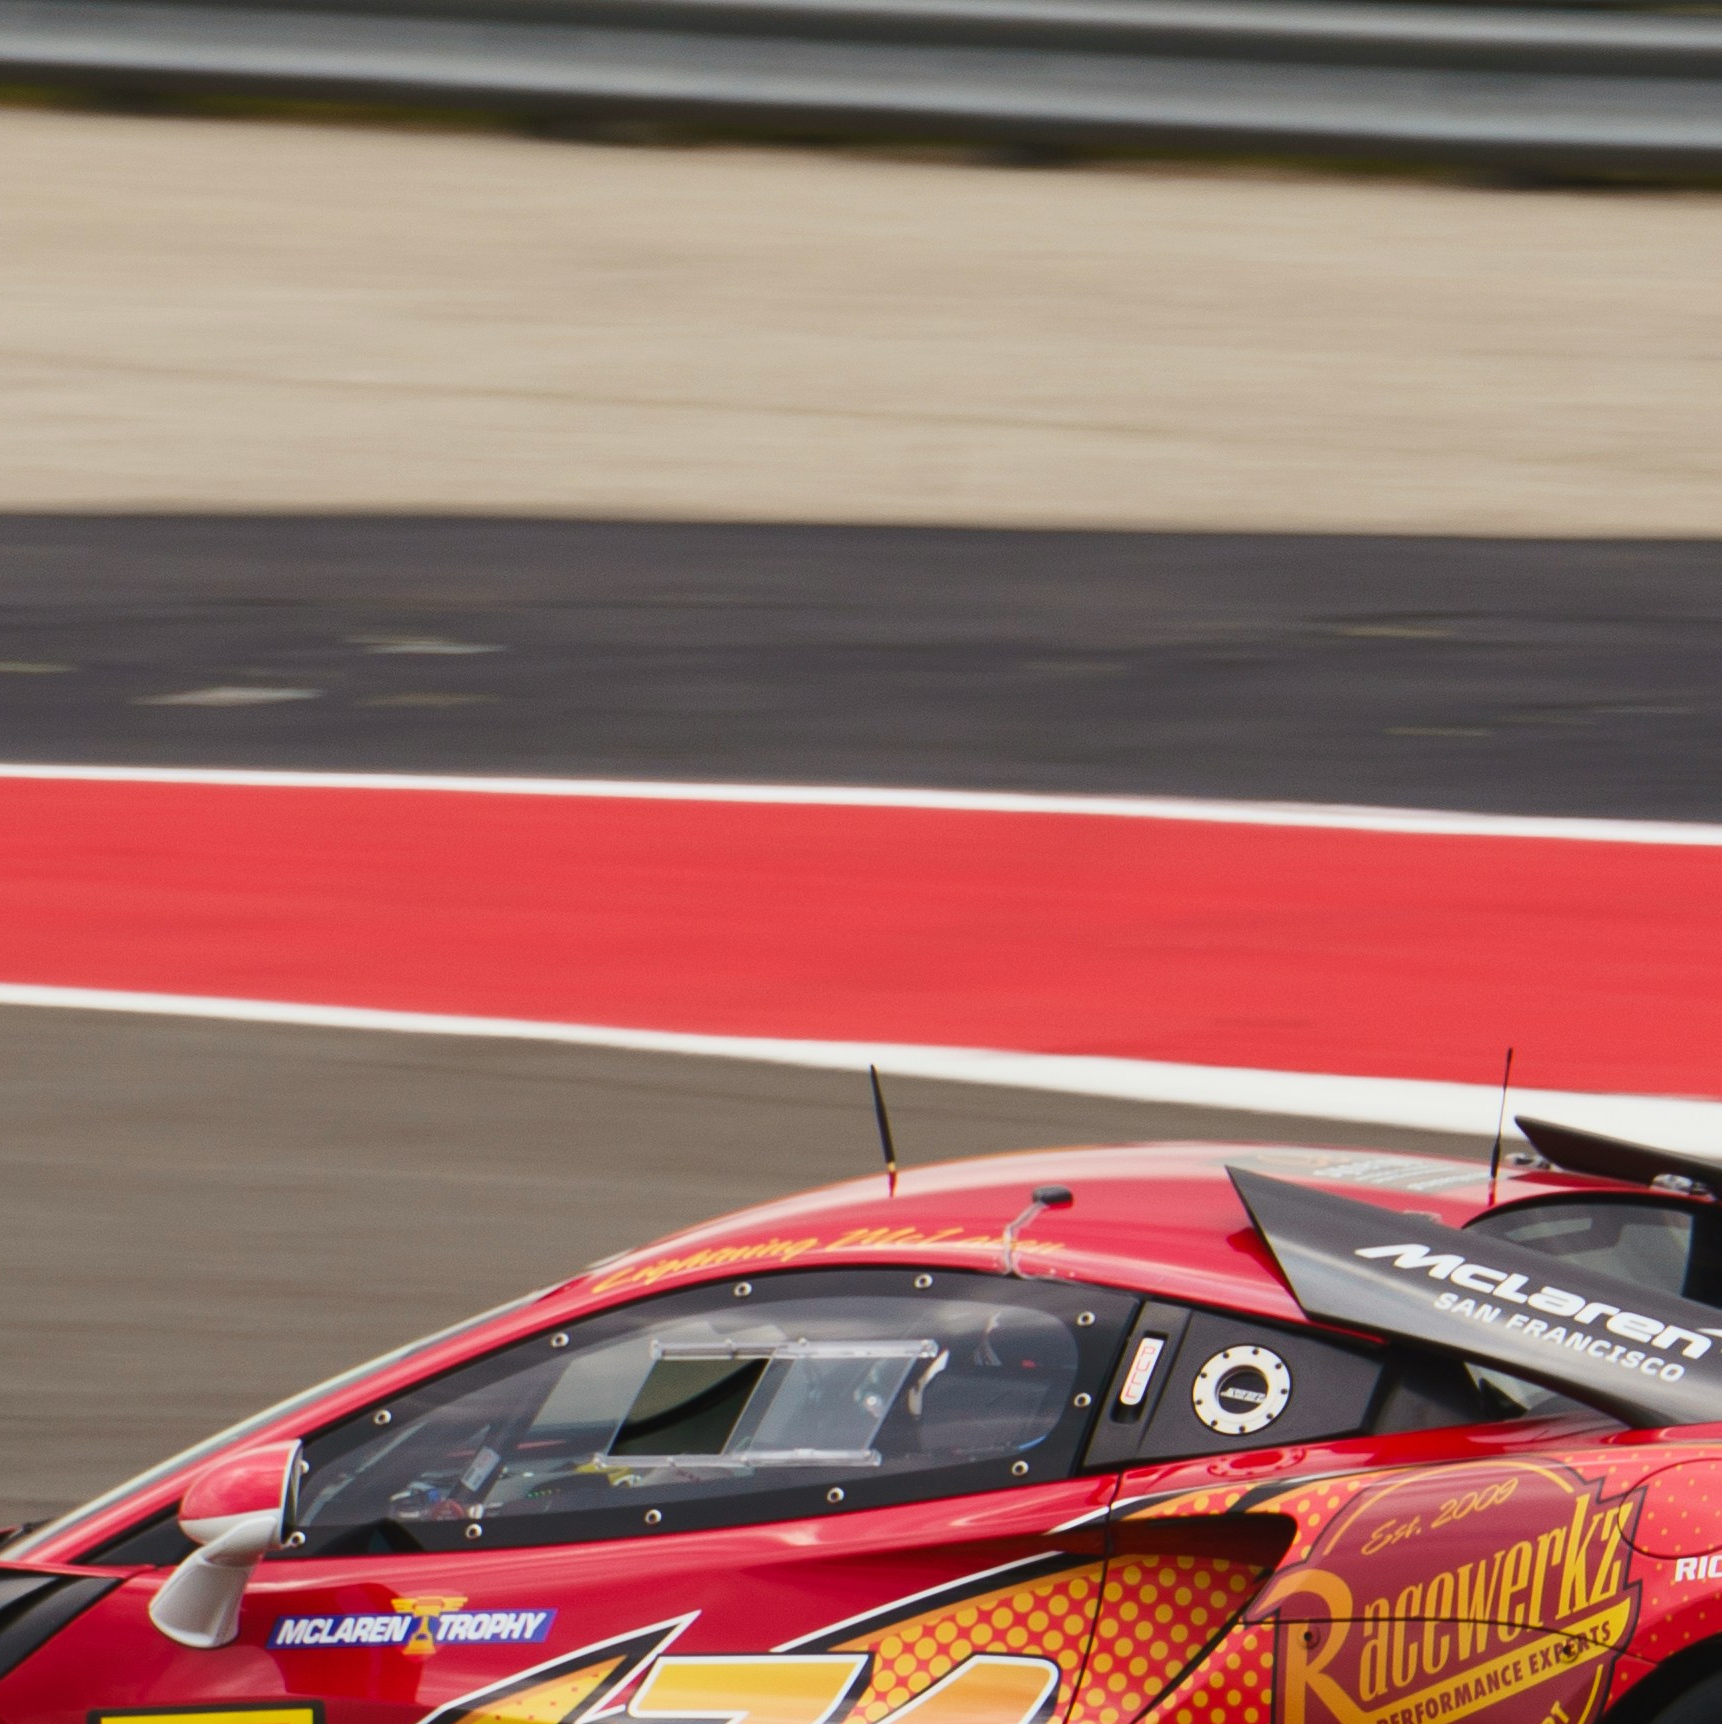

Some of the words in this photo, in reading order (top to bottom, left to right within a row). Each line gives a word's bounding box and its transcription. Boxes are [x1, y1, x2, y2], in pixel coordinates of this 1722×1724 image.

[1354, 1242, 1712, 1360] McLaren
[1433, 1291, 1502, 1324] SAN
[1505, 1312, 1687, 1383] FRANCISCO
[1124, 1345, 1157, 1399] PULL
[1360, 1515, 1422, 1556] Est.
[1430, 1476, 1520, 1530] 2009
[275, 1615, 412, 1646] MCLAREN
[434, 1611, 547, 1642] TROPHY
